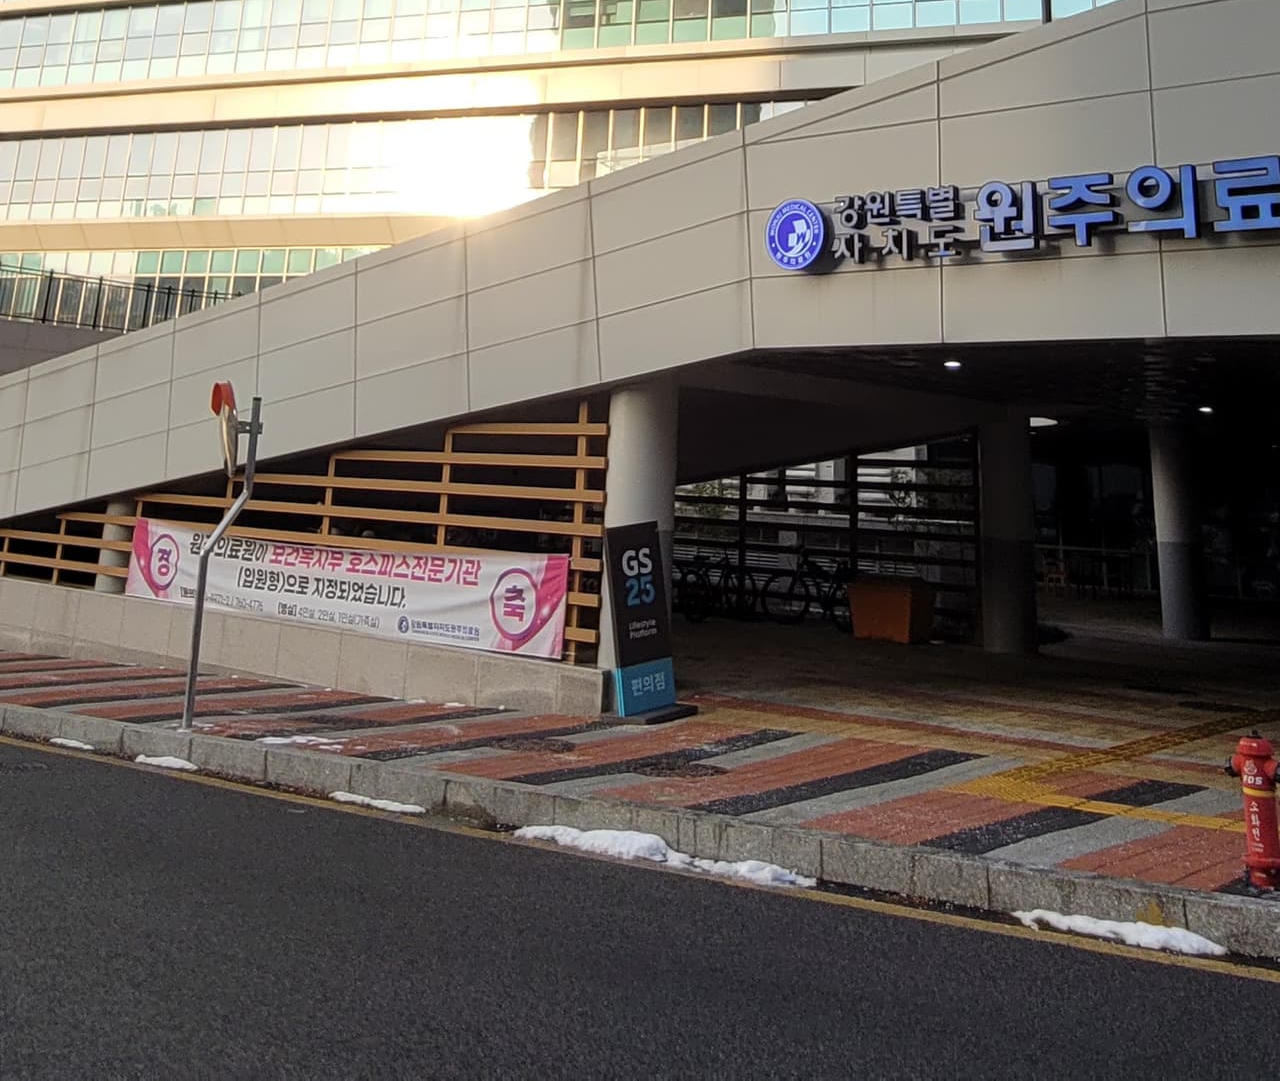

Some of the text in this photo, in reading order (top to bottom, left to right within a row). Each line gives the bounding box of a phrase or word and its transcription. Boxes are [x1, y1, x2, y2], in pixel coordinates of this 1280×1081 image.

[835, 186, 956, 228] 강원특별
[832, 226, 958, 264] 자치도
[190, 532, 269, 563] 원의료원이
[346, 551, 482, 586] 호스피스전문기관
[621, 547, 653, 577] GS
[502, 585, 527, 623] 축
[625, 575, 656, 607] 25
[631, 671, 666, 697] 편의점
